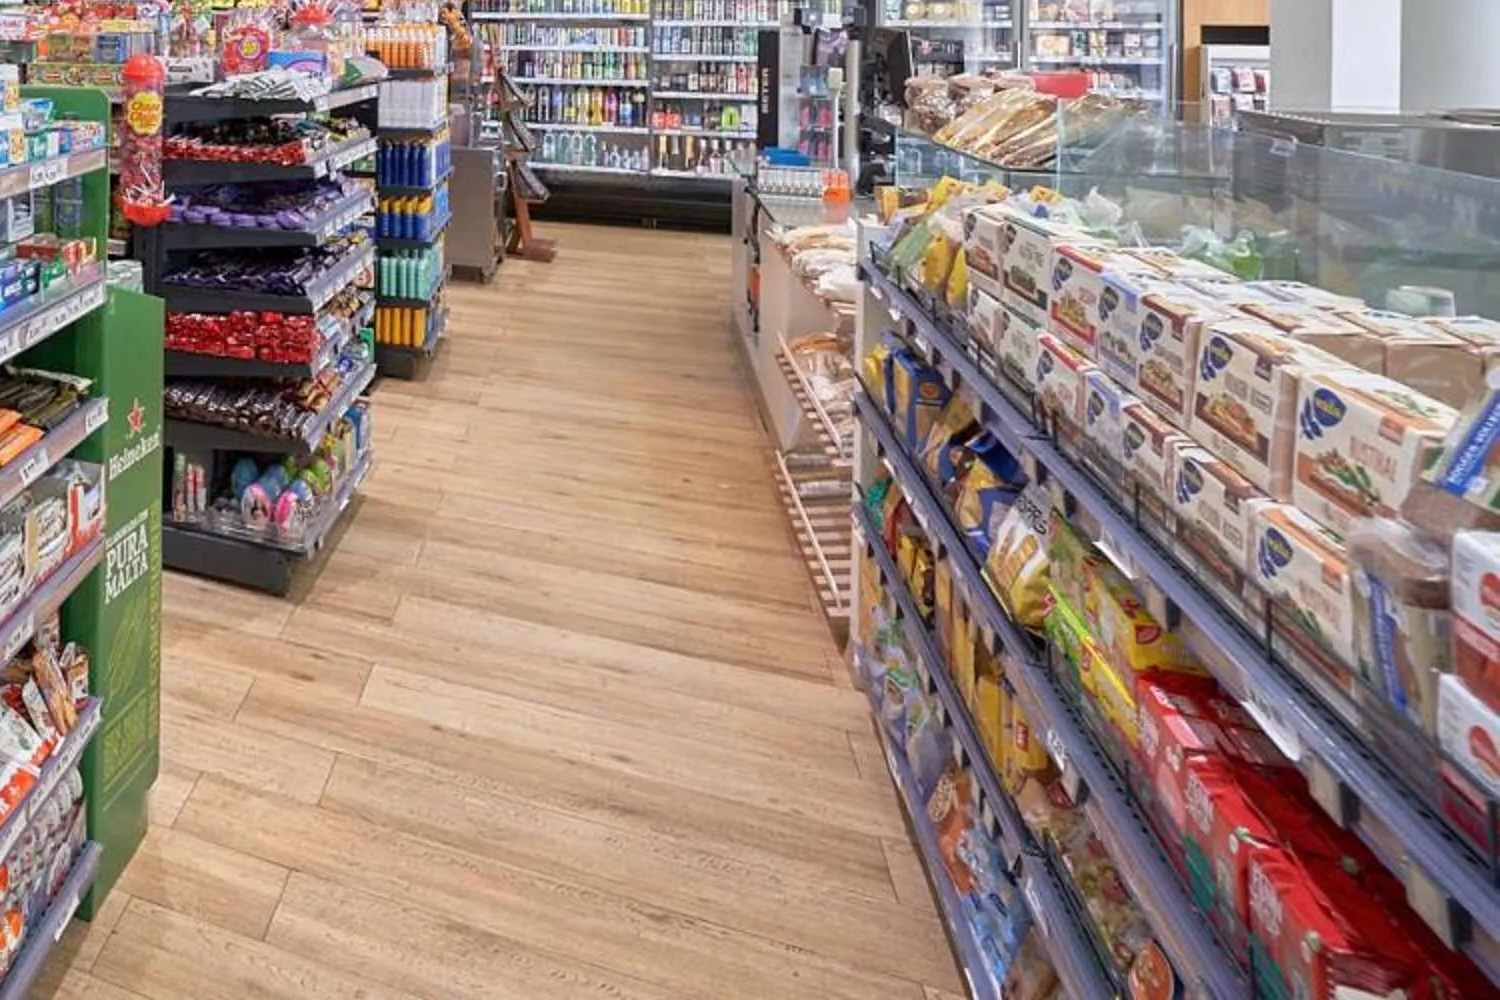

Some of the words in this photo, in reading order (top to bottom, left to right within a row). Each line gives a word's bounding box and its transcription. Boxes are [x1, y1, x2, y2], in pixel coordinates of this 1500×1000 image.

[109, 431, 161, 480] Heineken
[105, 523, 148, 580] PURA
[104, 552, 148, 605] MALTA
